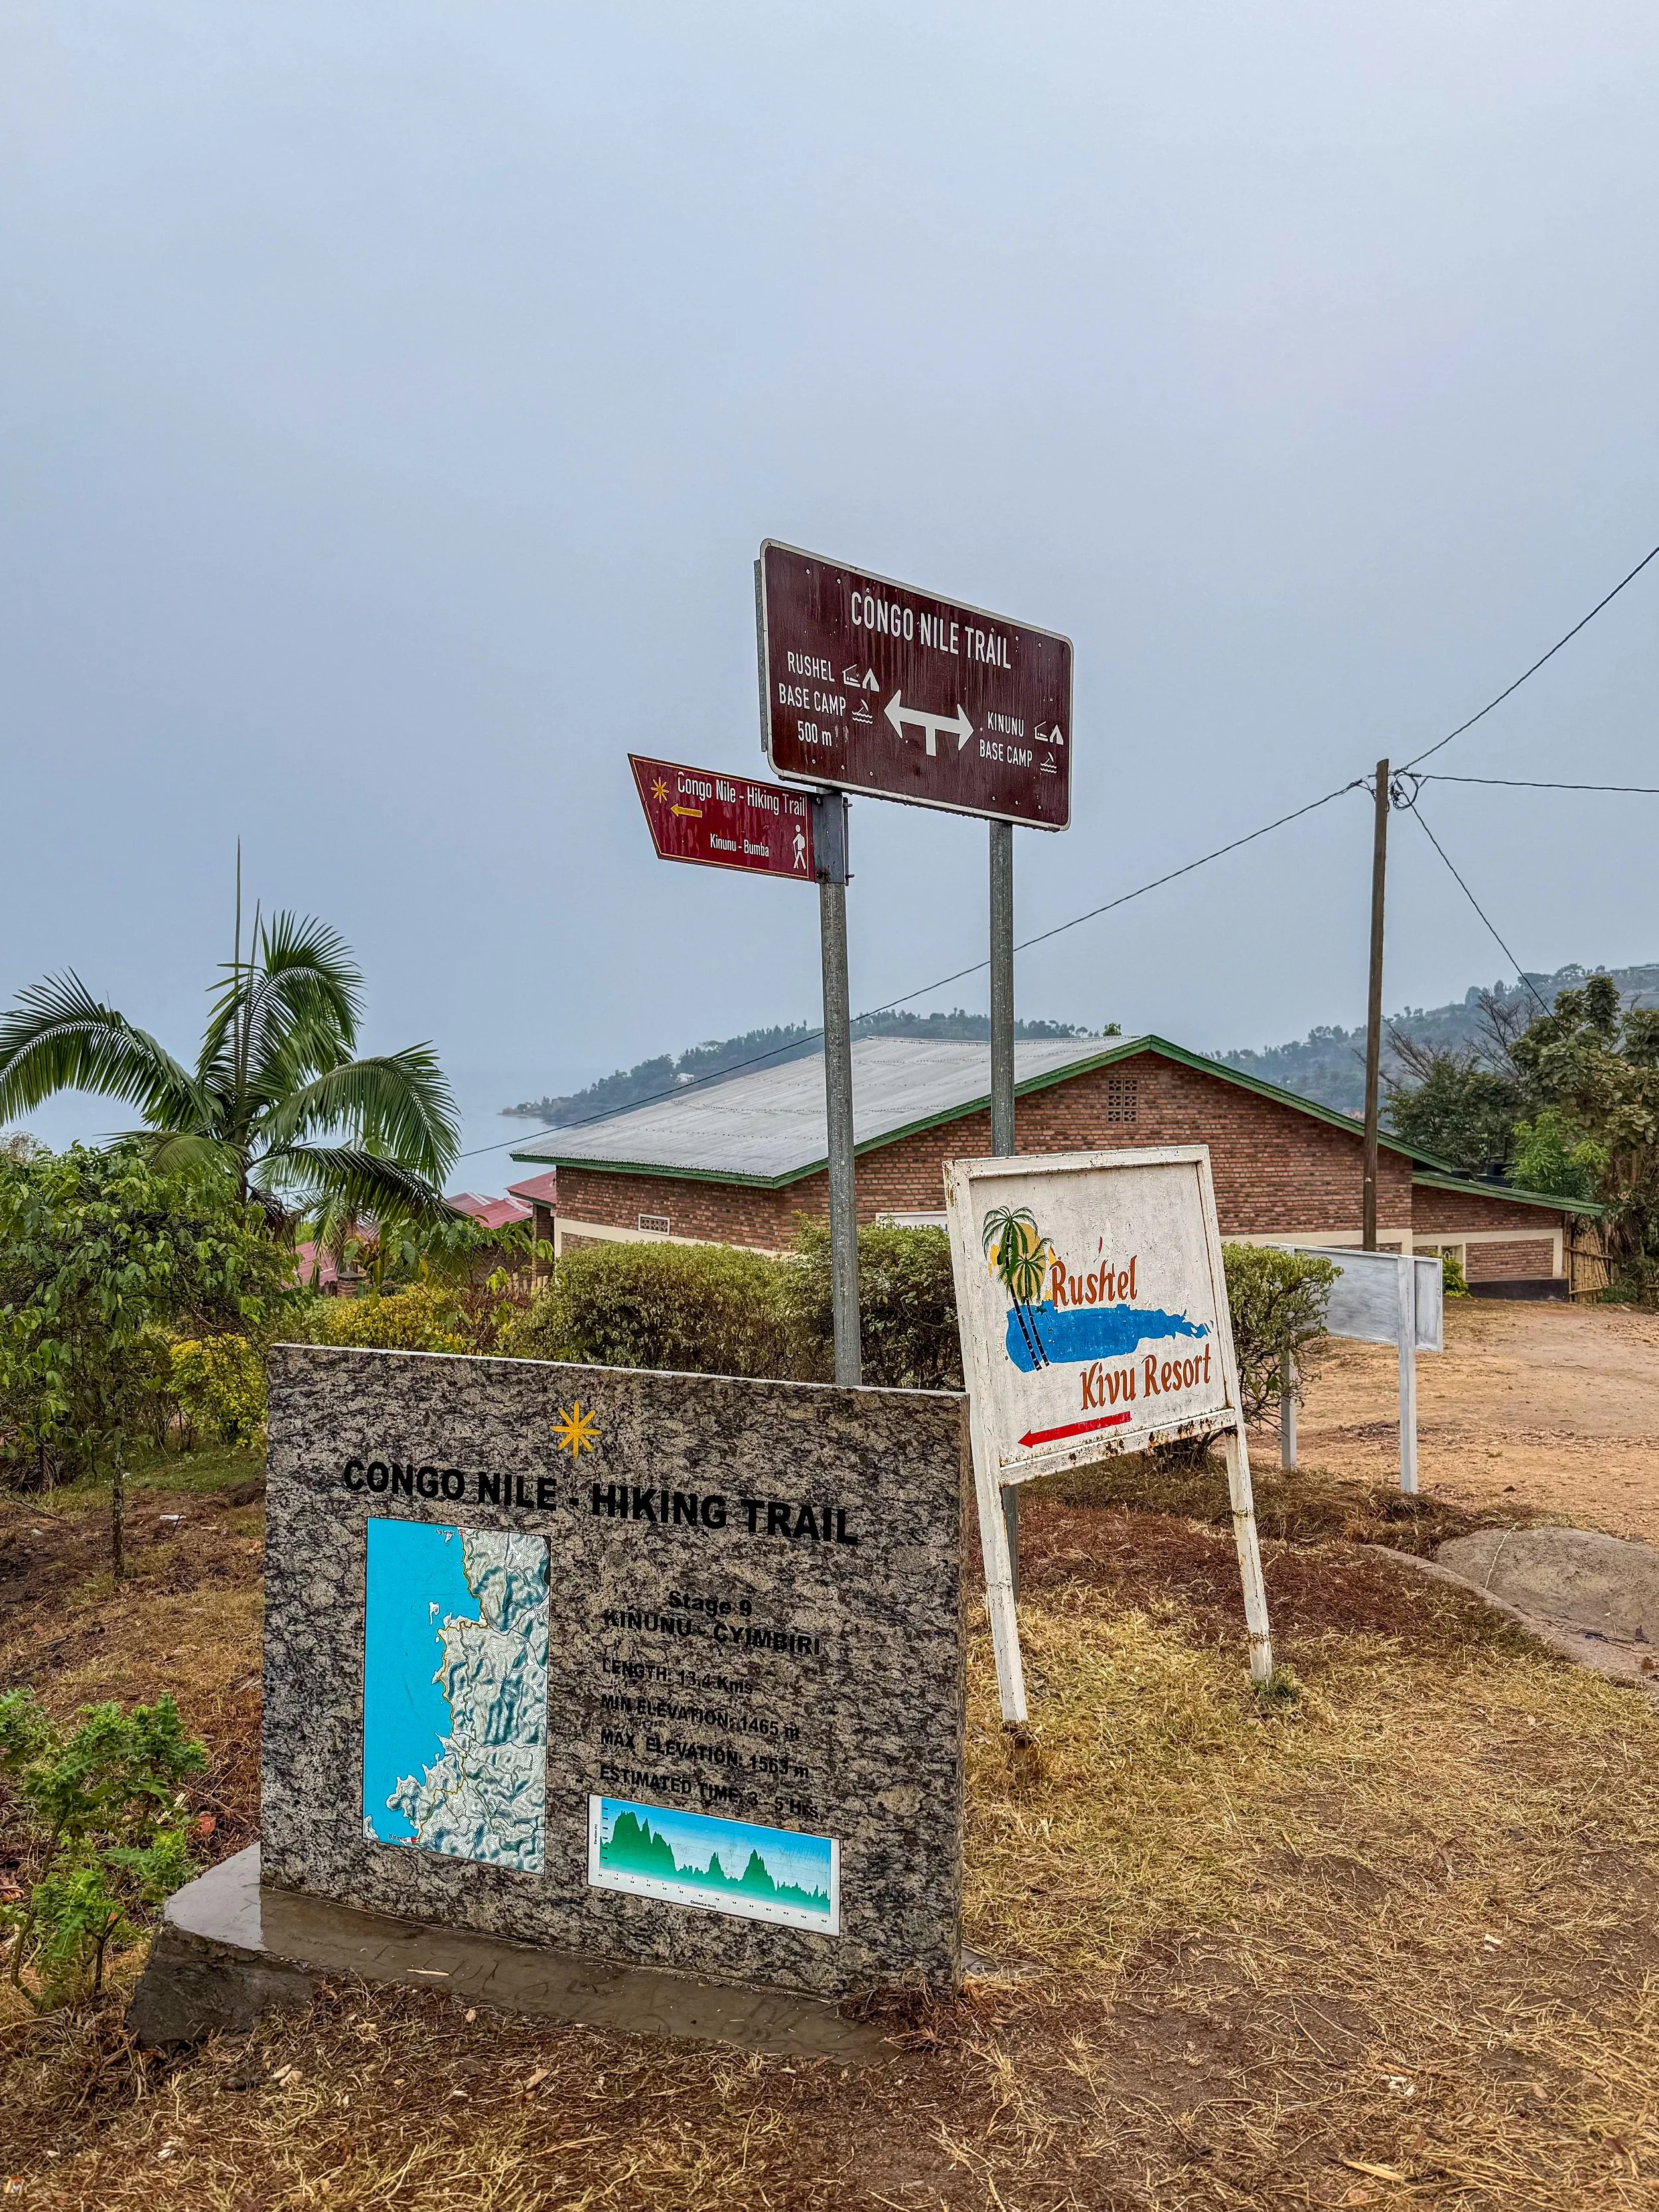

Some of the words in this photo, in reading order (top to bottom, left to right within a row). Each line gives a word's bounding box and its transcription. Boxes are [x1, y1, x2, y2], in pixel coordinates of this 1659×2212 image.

[851, 591, 913, 641] CONGO
[920, 612, 960, 655] NILE
[964, 626, 1011, 669] TRAIL
[787, 651, 835, 683] RUSHEL
[778, 682, 810, 710] BASE
[814, 691, 846, 717] CAMP
[797, 720, 818, 744] 500
[822, 730, 832, 747] m
[987, 711, 1024, 737] KINUNU
[979, 738, 1004, 762] BASE
[1007, 745, 1033, 768] CAMP
[678, 771, 712, 801] Congo
[715, 779, 736, 803] Nile
[747, 785, 780, 816] Hiking
[782, 793, 806, 817] Trail
[709, 833, 737, 852] Kinunu
[743, 839, 770, 857] Bumba
[1049, 1239, 1137, 1308] Rushel
[1079, 1361, 1137, 1411] Kivu
[1142, 1343, 1212, 1399] Resort
[344, 1458, 465, 1501] CONGO
[478, 1471, 557, 1512] NILE
[568, 1497, 580, 1506] -
[591, 1482, 727, 1529] HIKING
[740, 1497, 858, 1545] TRAIL
[668, 1590, 731, 1618] Stage
[739, 1599, 753, 1618] 9
[604, 1609, 692, 1637] KINUNU
[713, 1624, 821, 1656] CYIMBIRI
[716, 1675, 753, 1694] Kms
[601, 1694, 630, 1711] MIN
[741, 1714, 779, 1736] 1465
[784, 1726, 800, 1741] m
[601, 1728, 635, 1749] MAX
[750, 1754, 788, 1775] 1563
[794, 1764, 810, 1779] m
[600, 1765, 692, 1794] ESTIMATED
[774, 1796, 784, 1811] 5
[789, 1798, 819, 1819] Hrs
